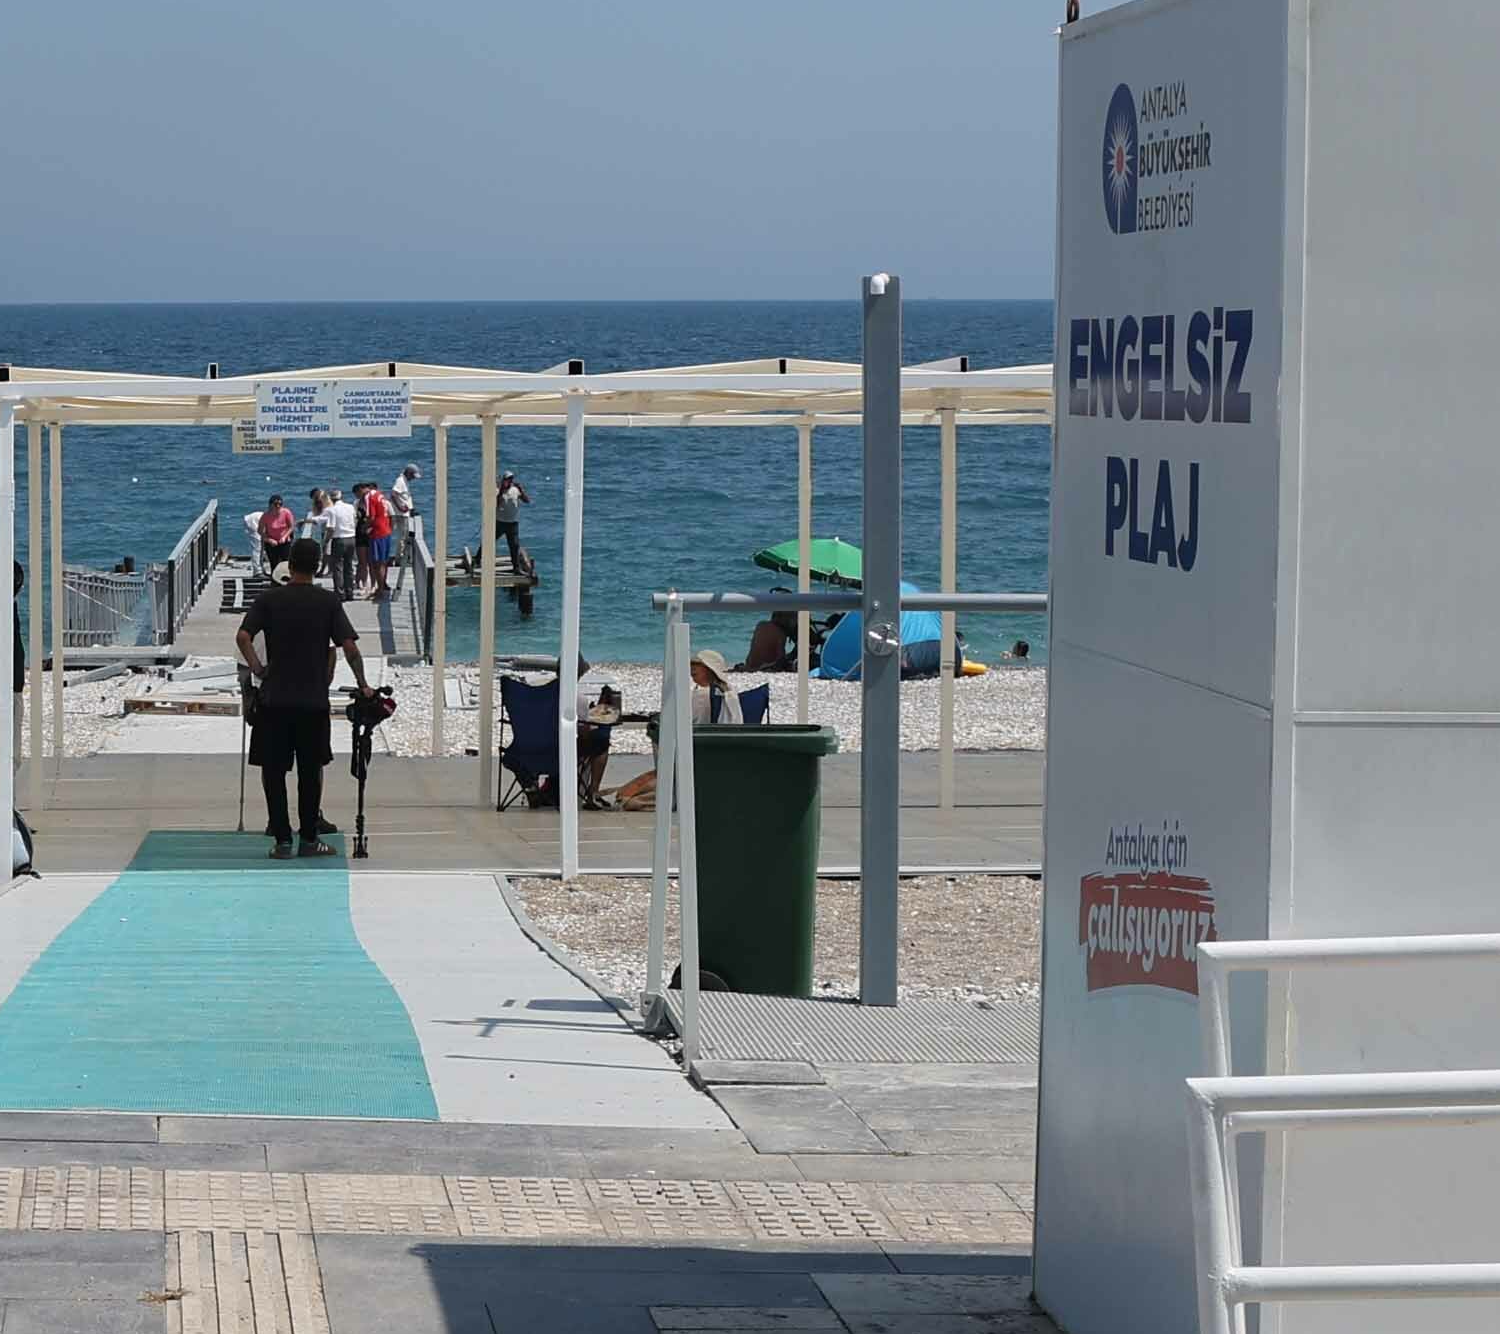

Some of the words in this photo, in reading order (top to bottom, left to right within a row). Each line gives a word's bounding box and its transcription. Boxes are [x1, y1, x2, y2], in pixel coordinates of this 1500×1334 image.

[1140, 79, 1188, 125] ANTALYA
[1138, 121, 1212, 181] BÜYÜKŞEHİR
[1137, 181, 1195, 232] BELEDİYESİ
[274, 396, 315, 404] SADECE
[276, 413, 312, 423] HİZMET
[259, 423, 330, 433] VERMEKTEDİR
[1104, 455, 1200, 573] PLAJ
[1105, 823, 1159, 881] Antalya
[1161, 819, 1188, 876] için
